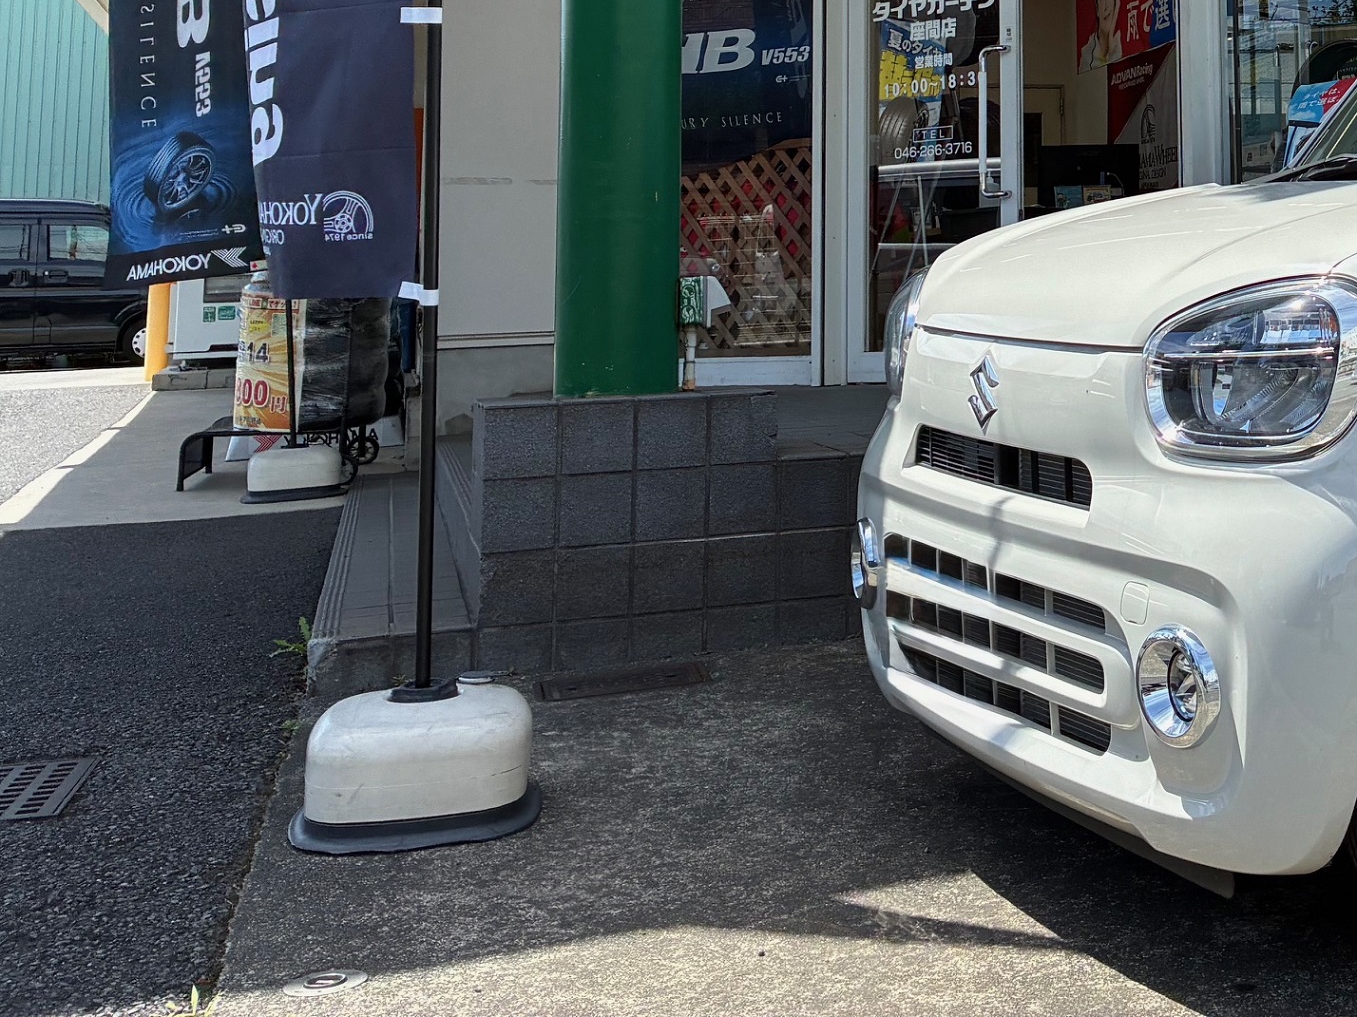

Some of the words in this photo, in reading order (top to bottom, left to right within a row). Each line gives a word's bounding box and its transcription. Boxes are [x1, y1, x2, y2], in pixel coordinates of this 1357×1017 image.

[909, 17, 957, 42] 座間店
[761, 46, 811, 66] V553
[914, 52, 953, 69] 営業時間
[884, 70, 980, 98] 10:00~18:3
[681, 117, 709, 130] URY
[721, 111, 783, 128] SILENCE
[921, 129, 946, 140] TEL
[894, 141, 973, 160] 046-266-3716
